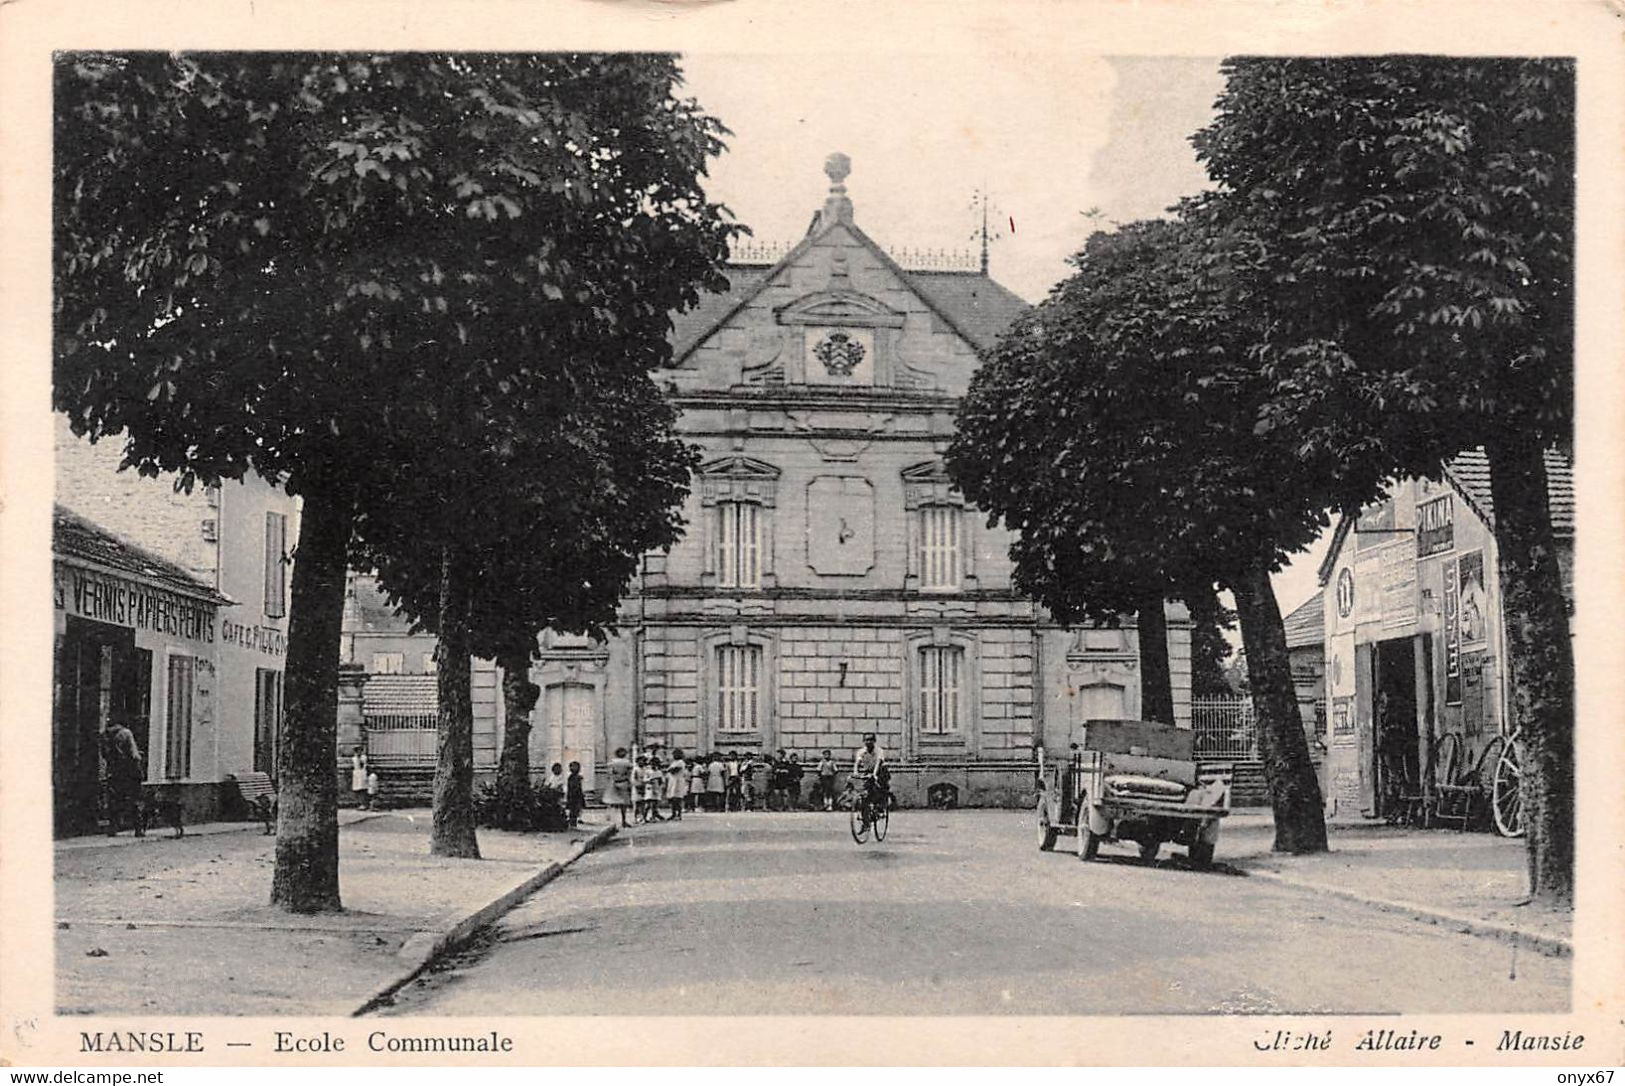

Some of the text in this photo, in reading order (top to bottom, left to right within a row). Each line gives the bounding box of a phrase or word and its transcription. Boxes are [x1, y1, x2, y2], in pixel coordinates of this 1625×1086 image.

[72, 572, 125, 623] VERNIS
[128, 587, 177, 636] PAPIERS
[179, 602, 214, 643] PEINTS
